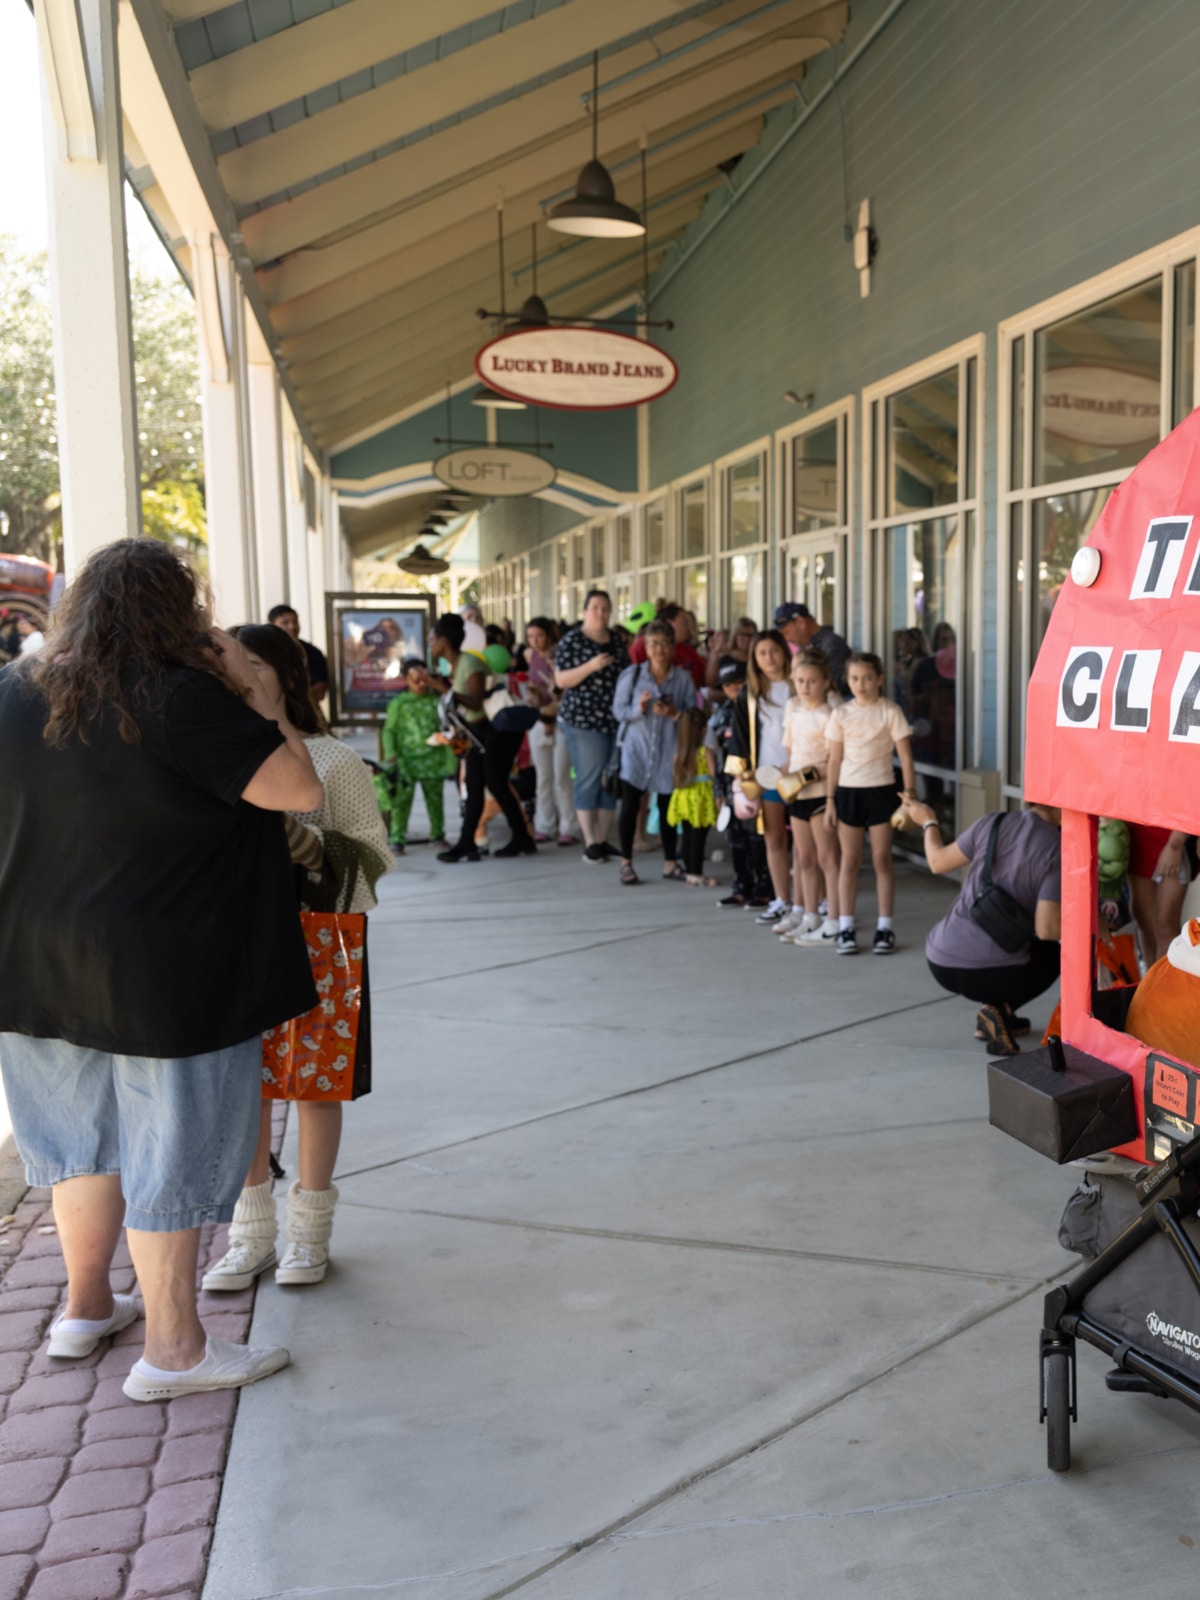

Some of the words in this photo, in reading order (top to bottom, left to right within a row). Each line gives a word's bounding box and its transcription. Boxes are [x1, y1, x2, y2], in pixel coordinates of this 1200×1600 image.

[492, 355, 547, 374] LUCKY
[552, 358, 610, 376] BRAND
[613, 361, 664, 379] JEANS
[448, 461, 511, 480] LOFT
[1156, 1080, 1172, 1092] Insert
[1172, 1087, 1185, 1098] Coin
[1161, 1093, 1168, 1101] to
[1168, 1095, 1180, 1107] Play
